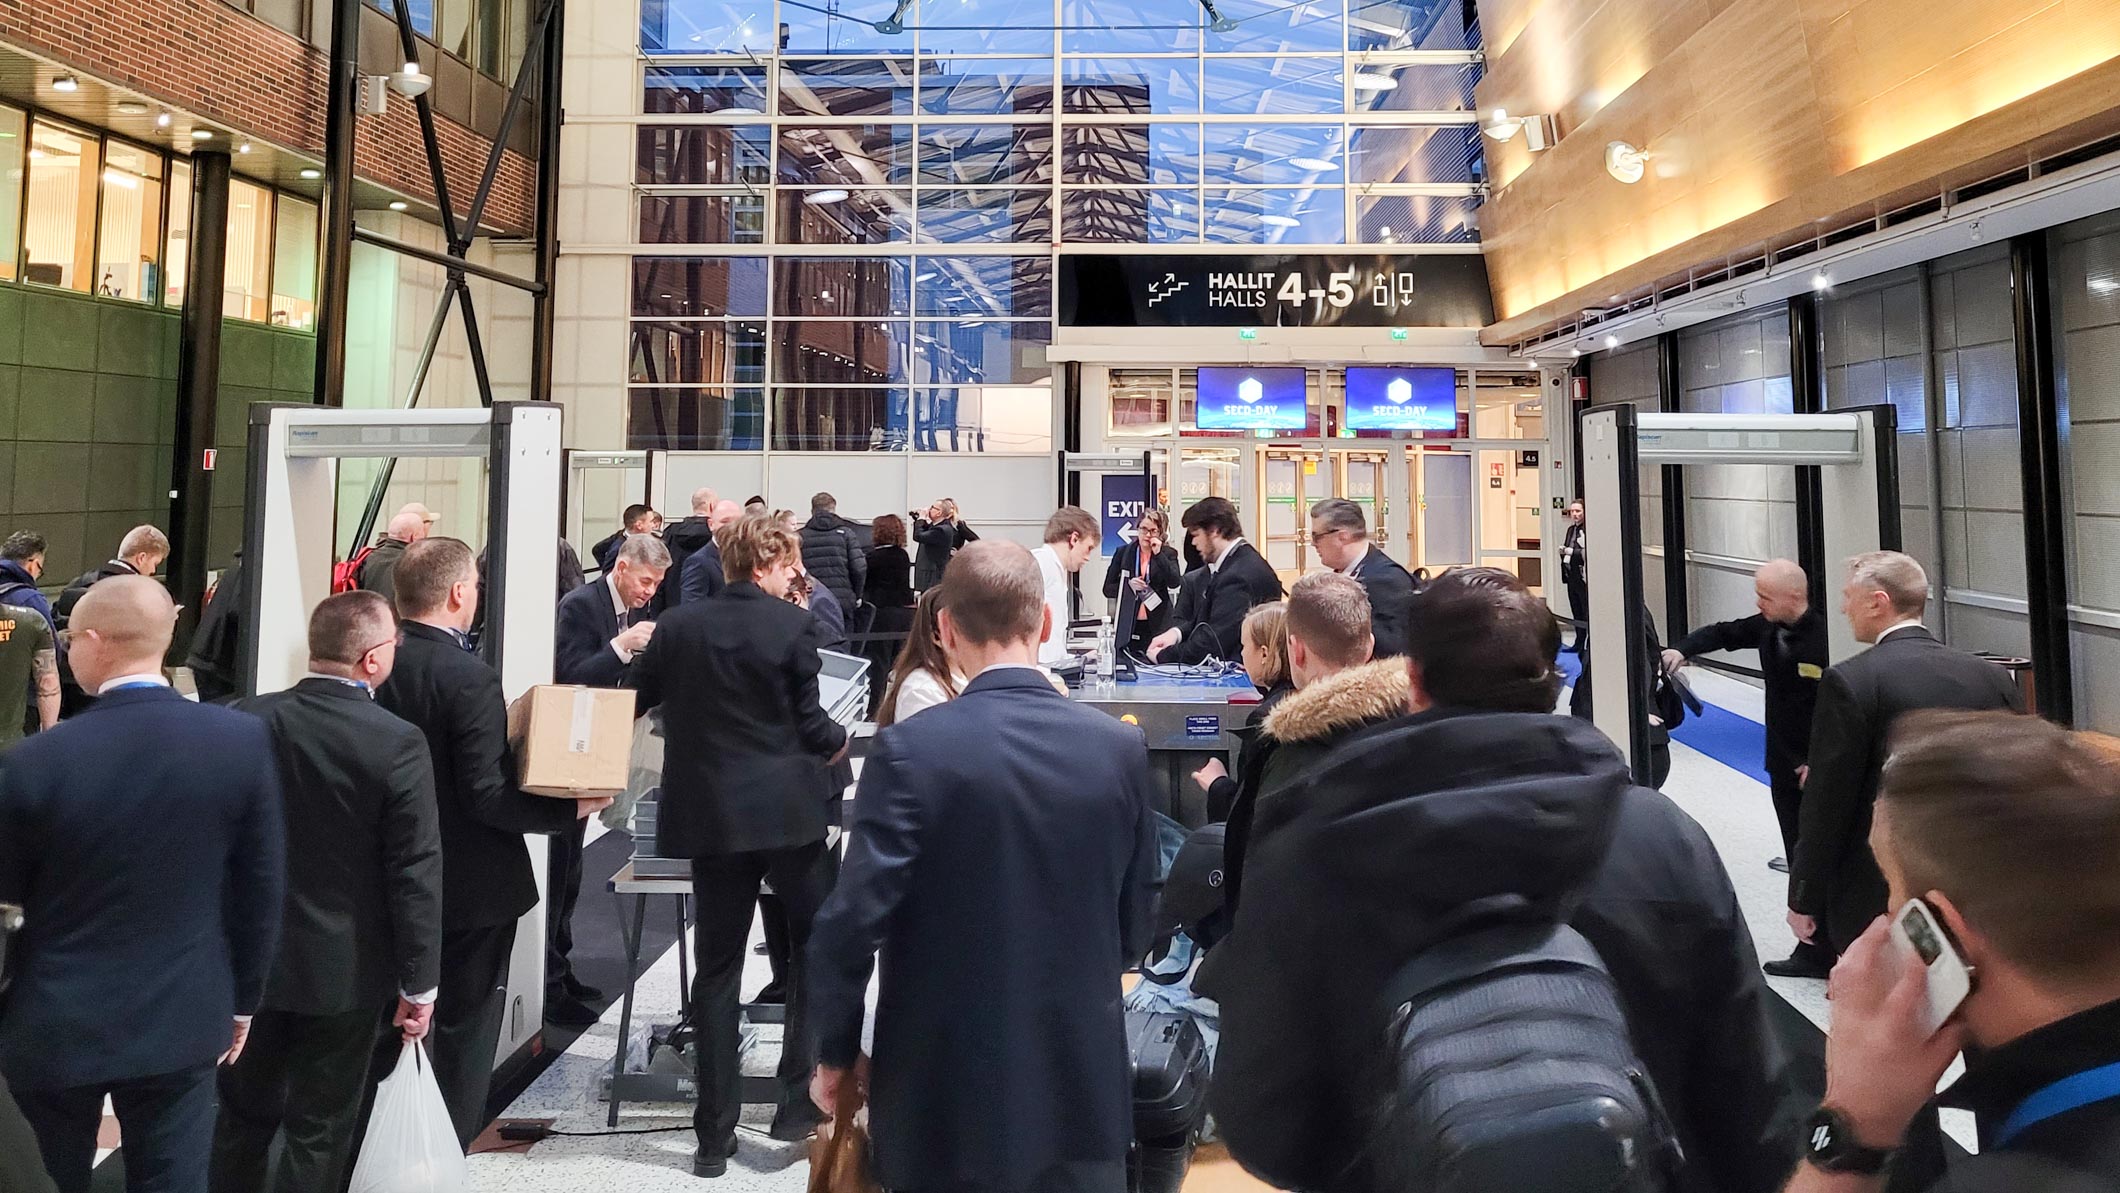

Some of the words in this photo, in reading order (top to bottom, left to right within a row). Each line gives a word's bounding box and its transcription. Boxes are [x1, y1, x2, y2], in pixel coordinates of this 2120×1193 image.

[1208, 272, 1275, 289] HALLIT
[1277, 272, 1354, 308] 4-5
[1209, 291, 1266, 307] HALLS
[1108, 501, 1145, 517] EXIT
